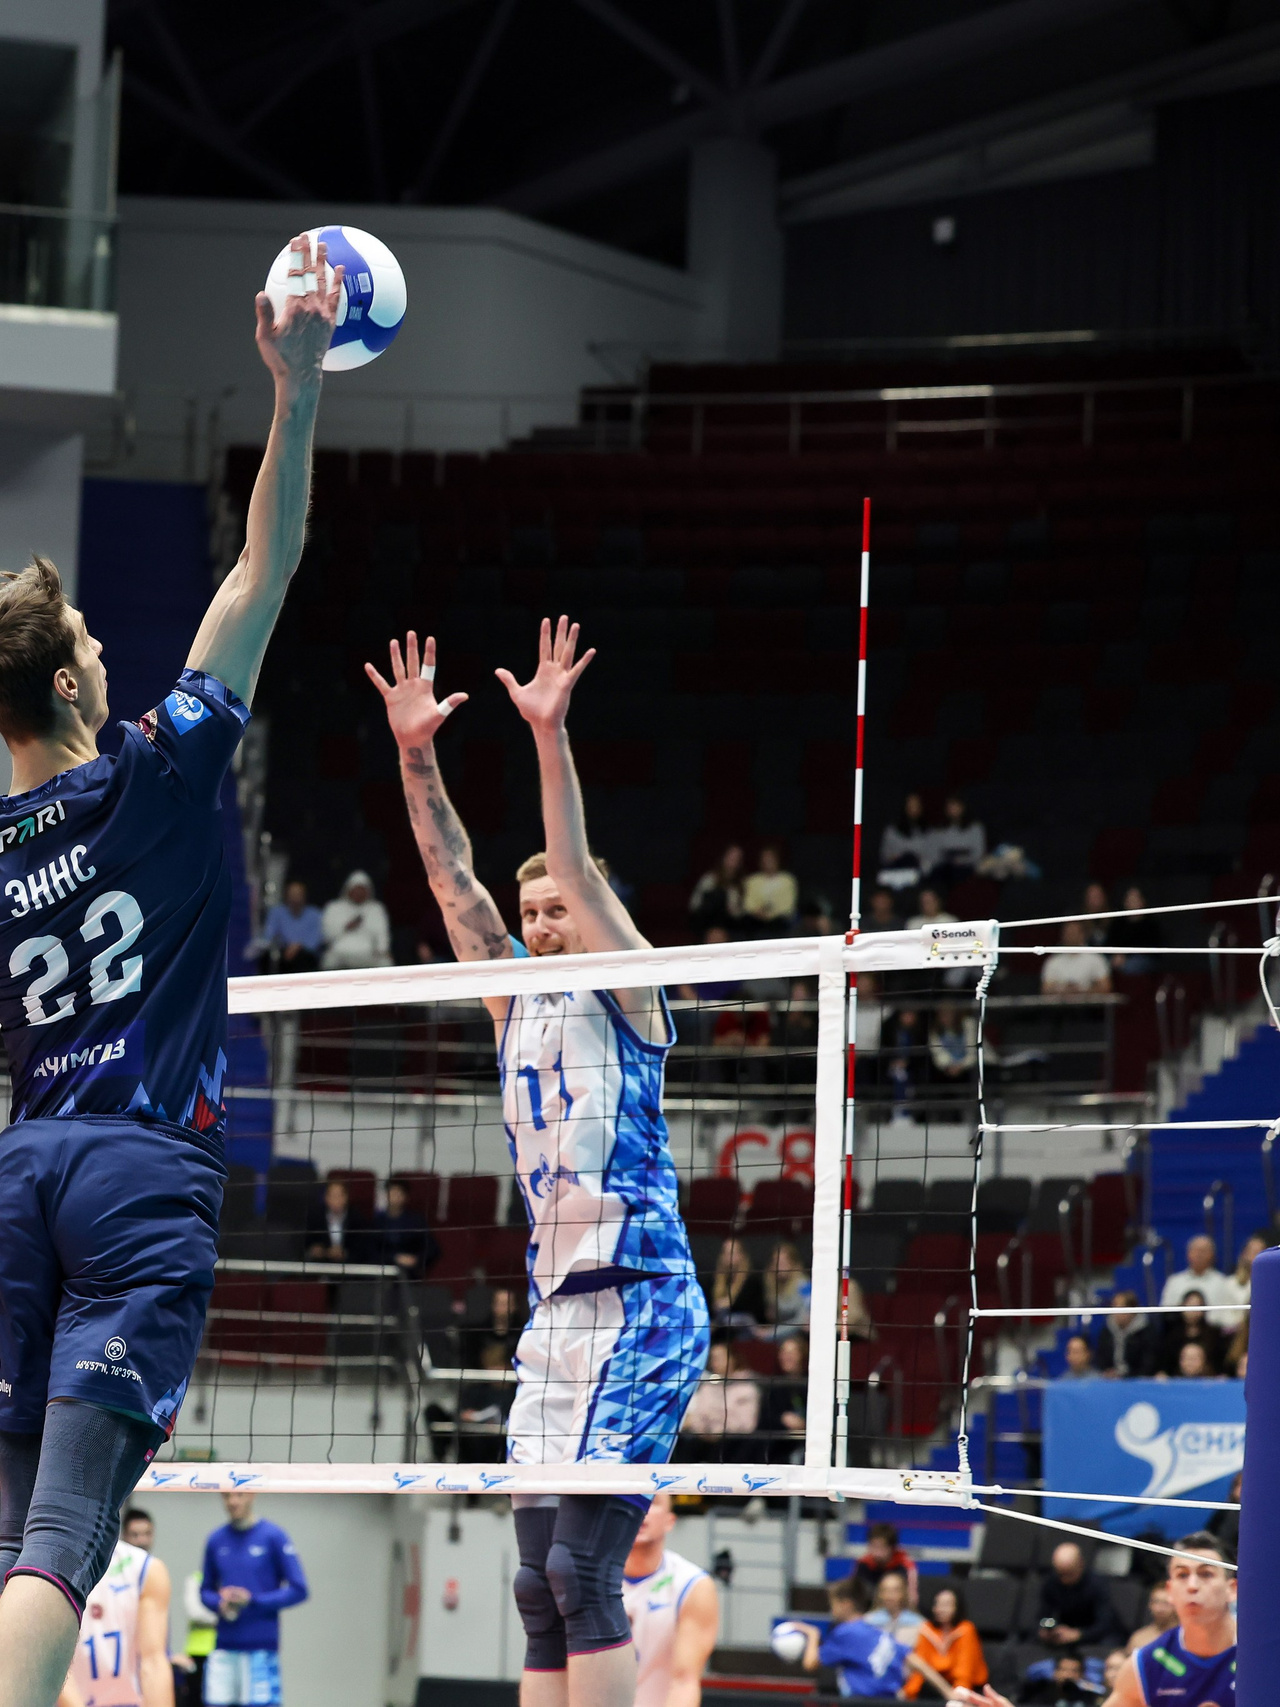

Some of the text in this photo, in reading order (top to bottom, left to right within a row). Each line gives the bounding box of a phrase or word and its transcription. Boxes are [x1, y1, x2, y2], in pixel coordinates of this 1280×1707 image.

[4, 844, 97, 918] ЭННС
[8, 890, 145, 1027] 22
[941, 929, 976, 939] Senoh
[84, 1631, 122, 1680] 17
